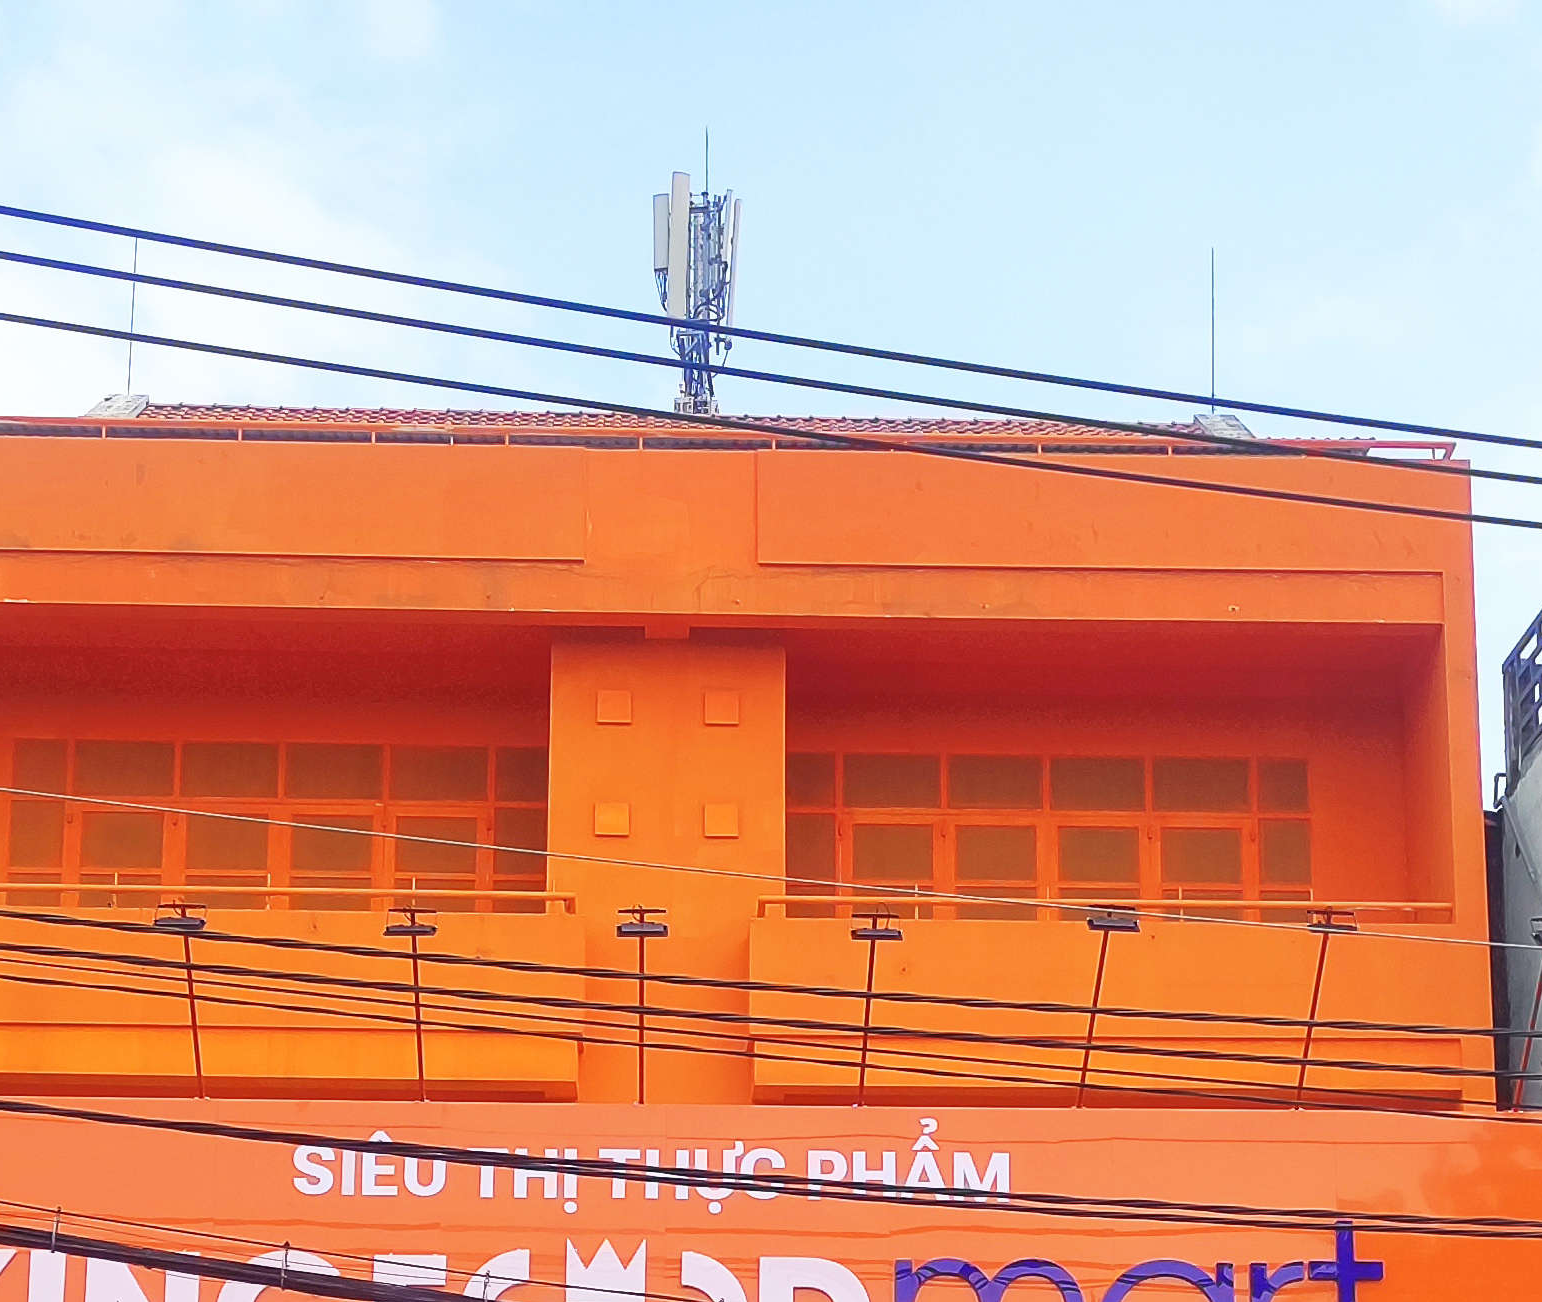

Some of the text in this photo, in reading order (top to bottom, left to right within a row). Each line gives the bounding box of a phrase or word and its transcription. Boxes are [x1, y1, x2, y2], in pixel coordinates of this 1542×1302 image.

[293, 1118, 1010, 1215] SIÊU THỊ THỰC PHẨM
